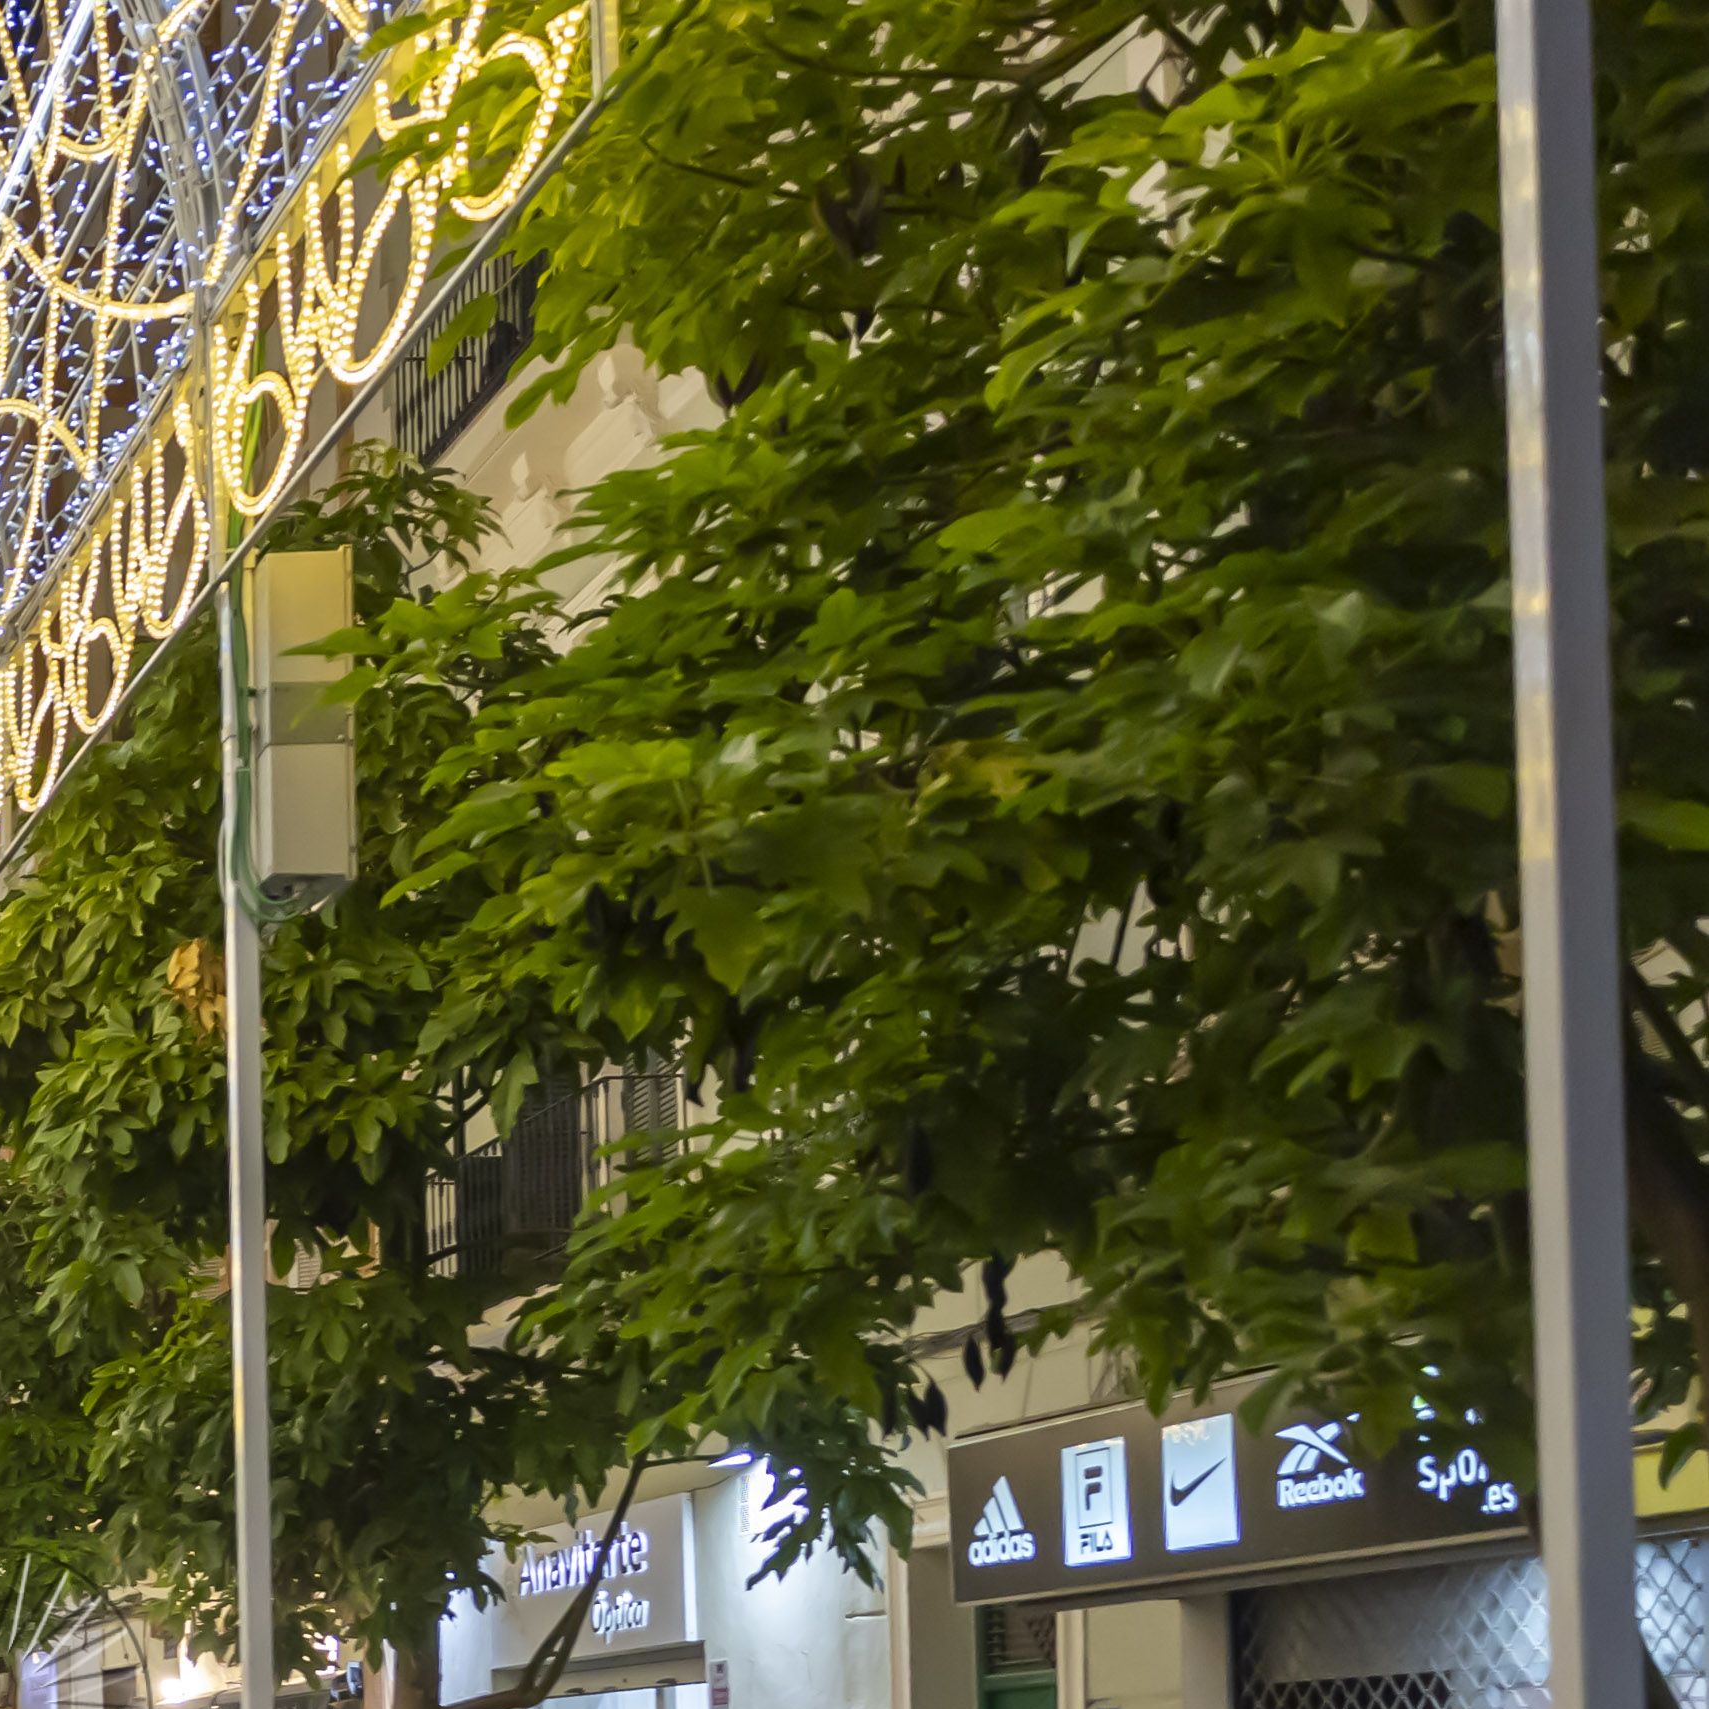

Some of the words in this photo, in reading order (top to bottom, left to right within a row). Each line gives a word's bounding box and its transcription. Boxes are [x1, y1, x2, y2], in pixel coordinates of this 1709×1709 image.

[1277, 1467, 1366, 1509] Reebok
[968, 1530, 1037, 1567] adidas
[1080, 1531, 1113, 1554] FILA
